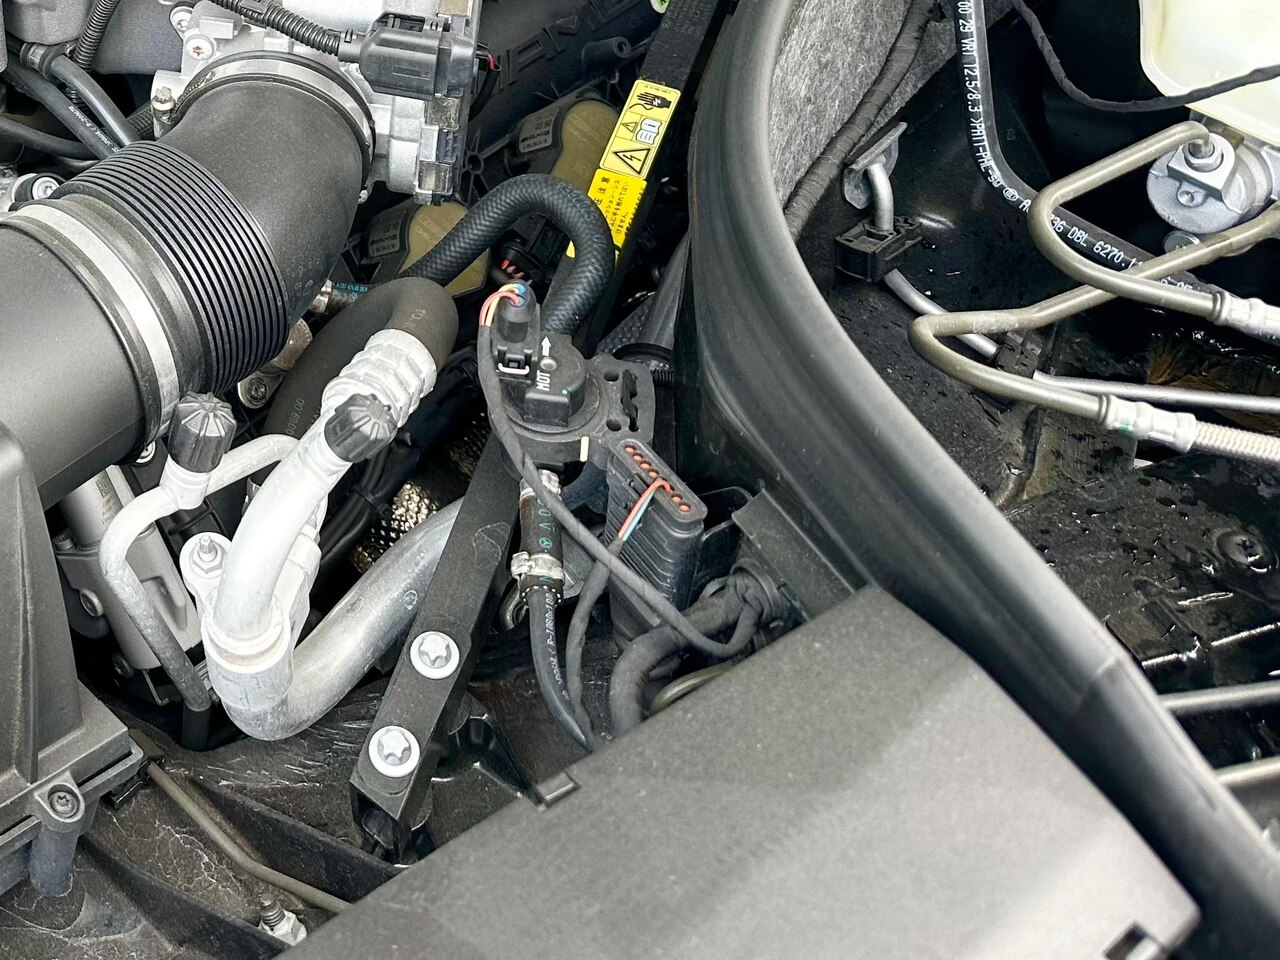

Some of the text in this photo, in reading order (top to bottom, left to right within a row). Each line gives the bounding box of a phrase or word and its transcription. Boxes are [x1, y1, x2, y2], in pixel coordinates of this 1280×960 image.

[958, 1, 973, 14] 00
[959, 19, 974, 32] 29
[1067, 226, 1087, 247] DBL
[536, 369, 551, 391] MOT
